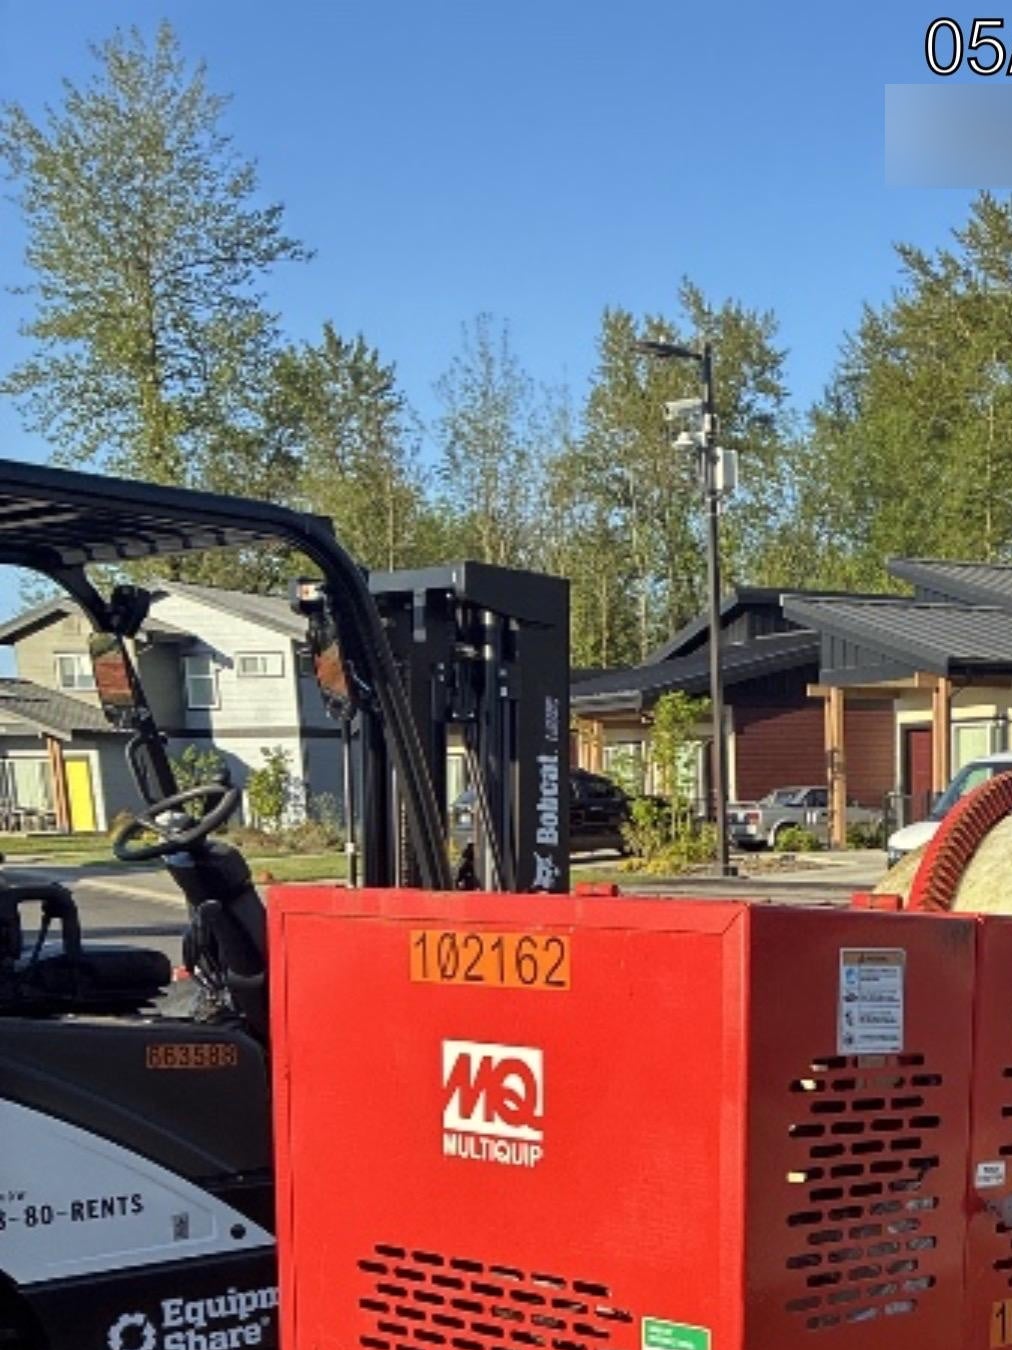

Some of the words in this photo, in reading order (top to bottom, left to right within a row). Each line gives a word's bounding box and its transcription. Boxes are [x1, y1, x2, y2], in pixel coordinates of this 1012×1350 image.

[536, 754, 559, 846] Bobcat
[415, 932, 566, 986] 102162
[442, 1048, 543, 1134] MQ
[443, 1132, 543, 1168] MULTIQUIP
